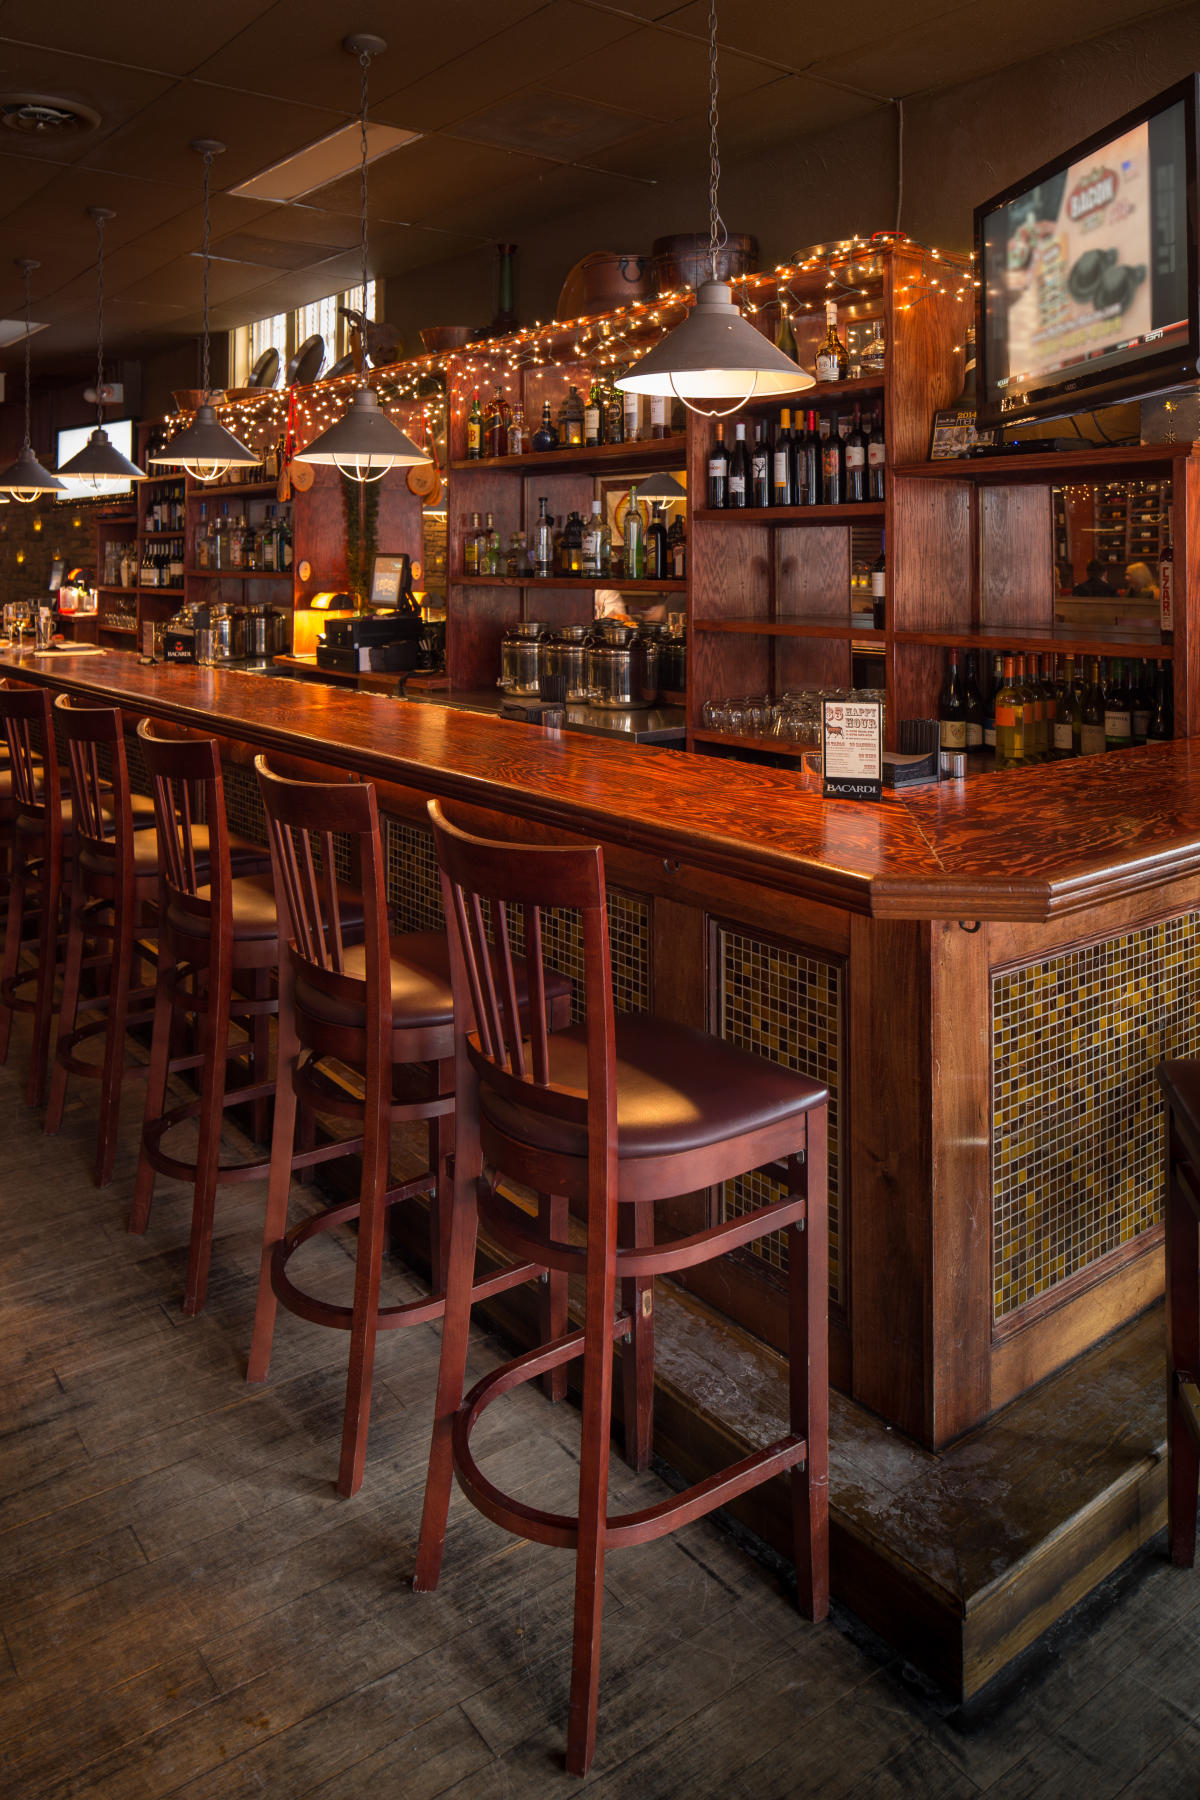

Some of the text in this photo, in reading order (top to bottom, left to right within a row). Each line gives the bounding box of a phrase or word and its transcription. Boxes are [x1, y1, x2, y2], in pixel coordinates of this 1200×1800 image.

[1071, 175, 1114, 218] BACON
[1145, 330, 1164, 342] ESPN
[845, 707, 876, 717] HAPPY
[845, 717, 877, 729] HOUR
[826, 783, 876, 794] BACARDI
